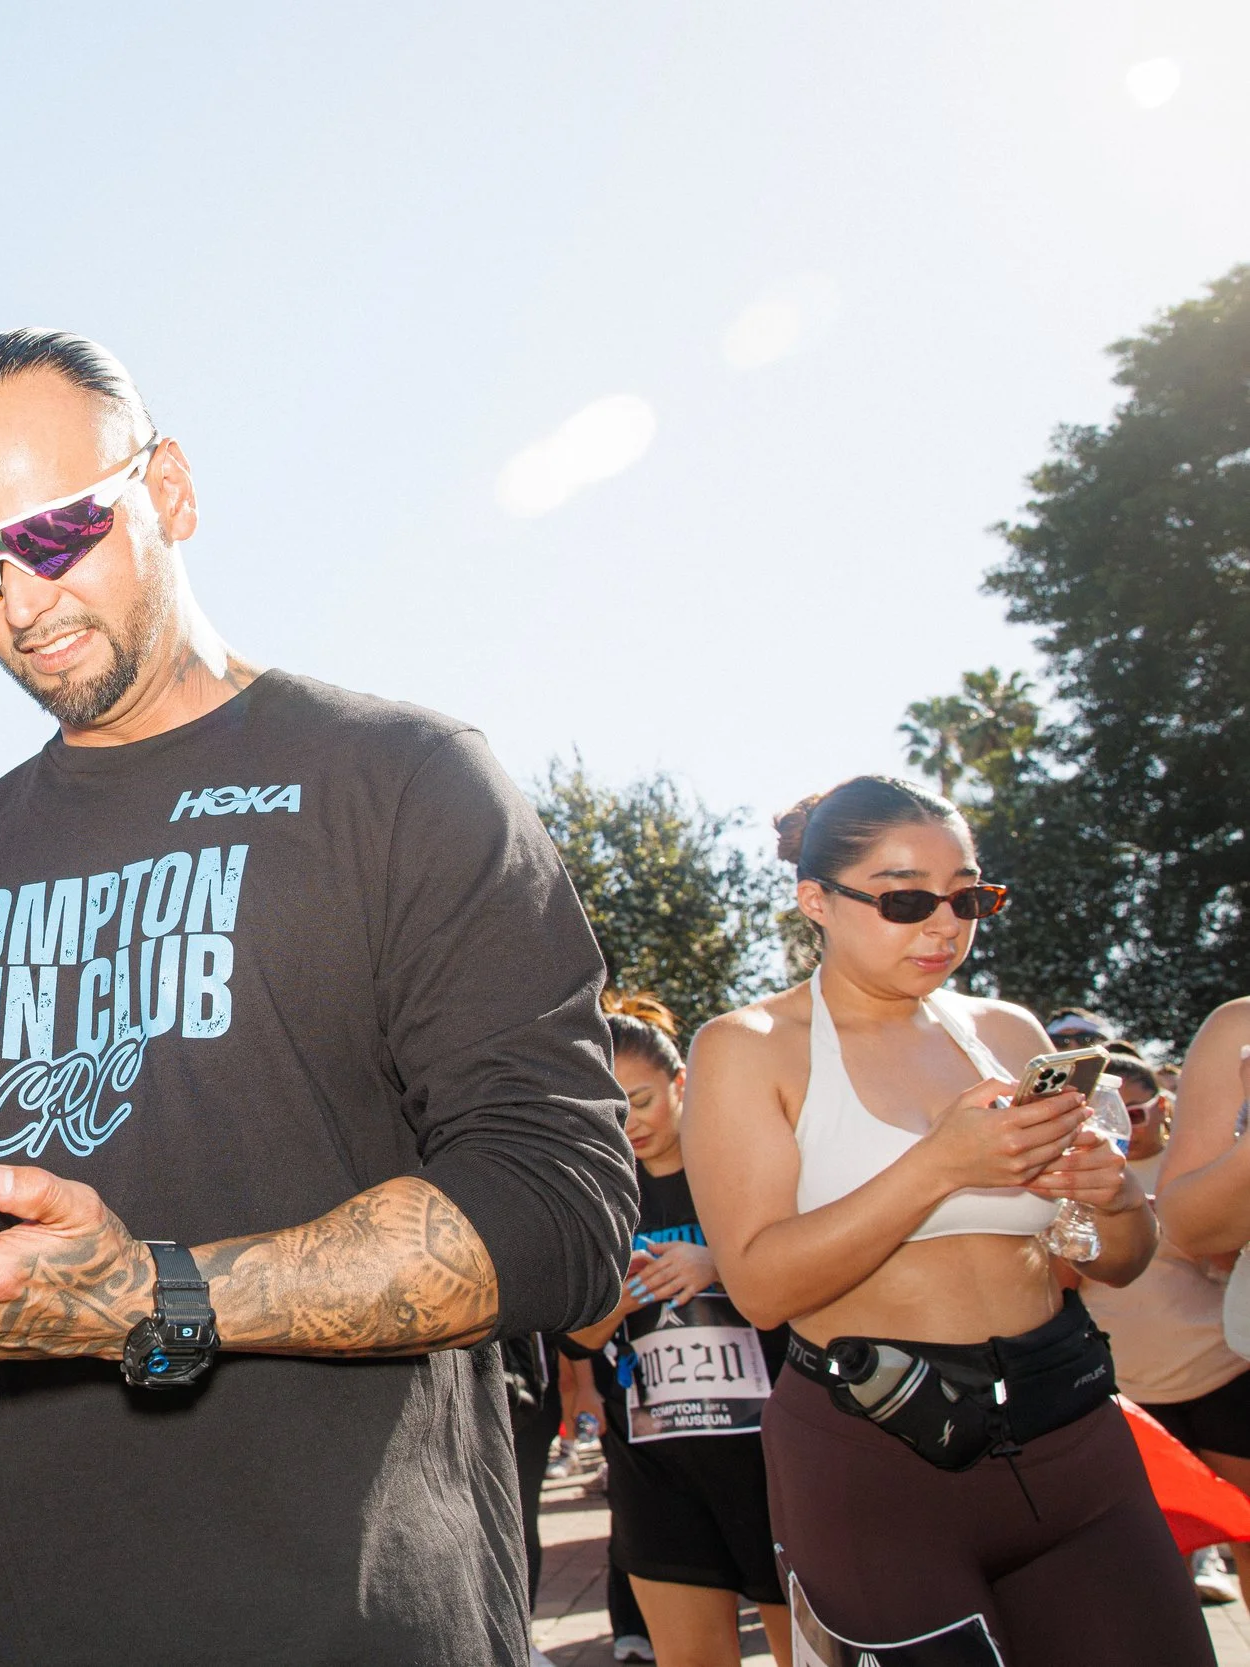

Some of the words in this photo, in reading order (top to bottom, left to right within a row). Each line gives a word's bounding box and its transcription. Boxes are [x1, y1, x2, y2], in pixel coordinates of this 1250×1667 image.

[169, 784, 301, 822] HOKA
[76, 934, 234, 1054] CLUB
[650, 1403, 702, 1418] COMPTON
[674, 1414, 732, 1427] MUSEUM
